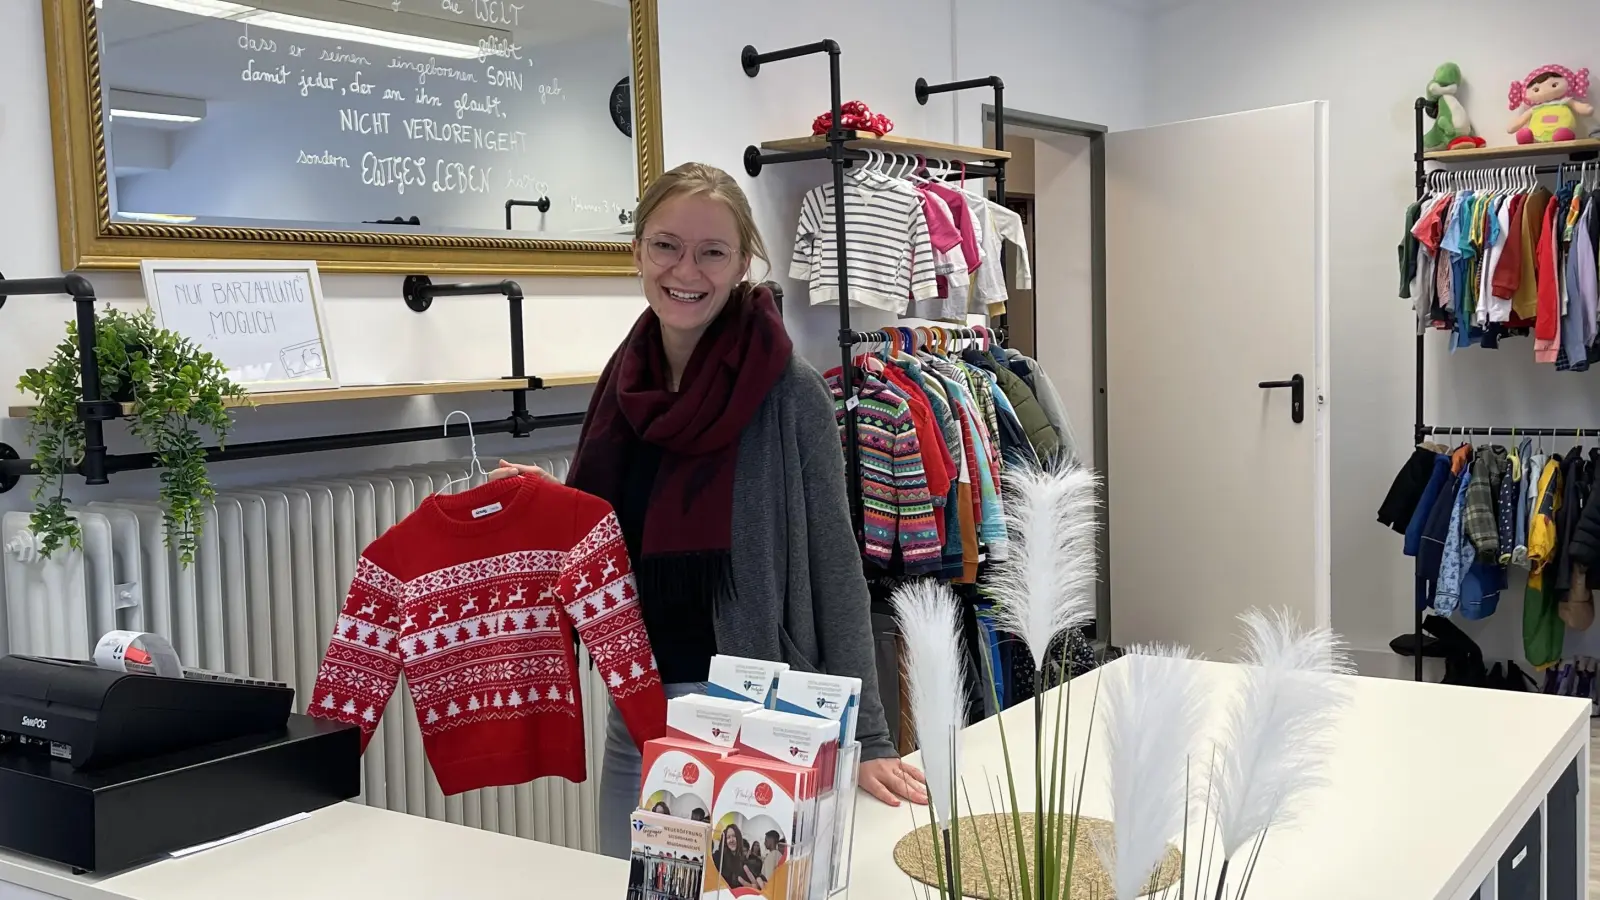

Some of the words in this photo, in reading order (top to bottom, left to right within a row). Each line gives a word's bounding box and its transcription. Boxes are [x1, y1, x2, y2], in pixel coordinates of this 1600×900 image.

[472, 0, 525, 25] WELT
[238, 18, 277, 52] dass
[288, 44, 306, 57] er
[319, 46, 371, 66] seinen
[387, 56, 478, 84] eingeborenen
[487, 65, 523, 91] SOHN
[241, 59, 291, 84] damit
[350, 71, 376, 94] der
[382, 90, 406, 101] an
[415, 87, 442, 106] ihn
[339, 108, 391, 134] NICHT
[296, 149, 350, 168] sondern
[432, 159, 492, 194] LEBEN
[212, 278, 304, 304] BARZAHLUNG
